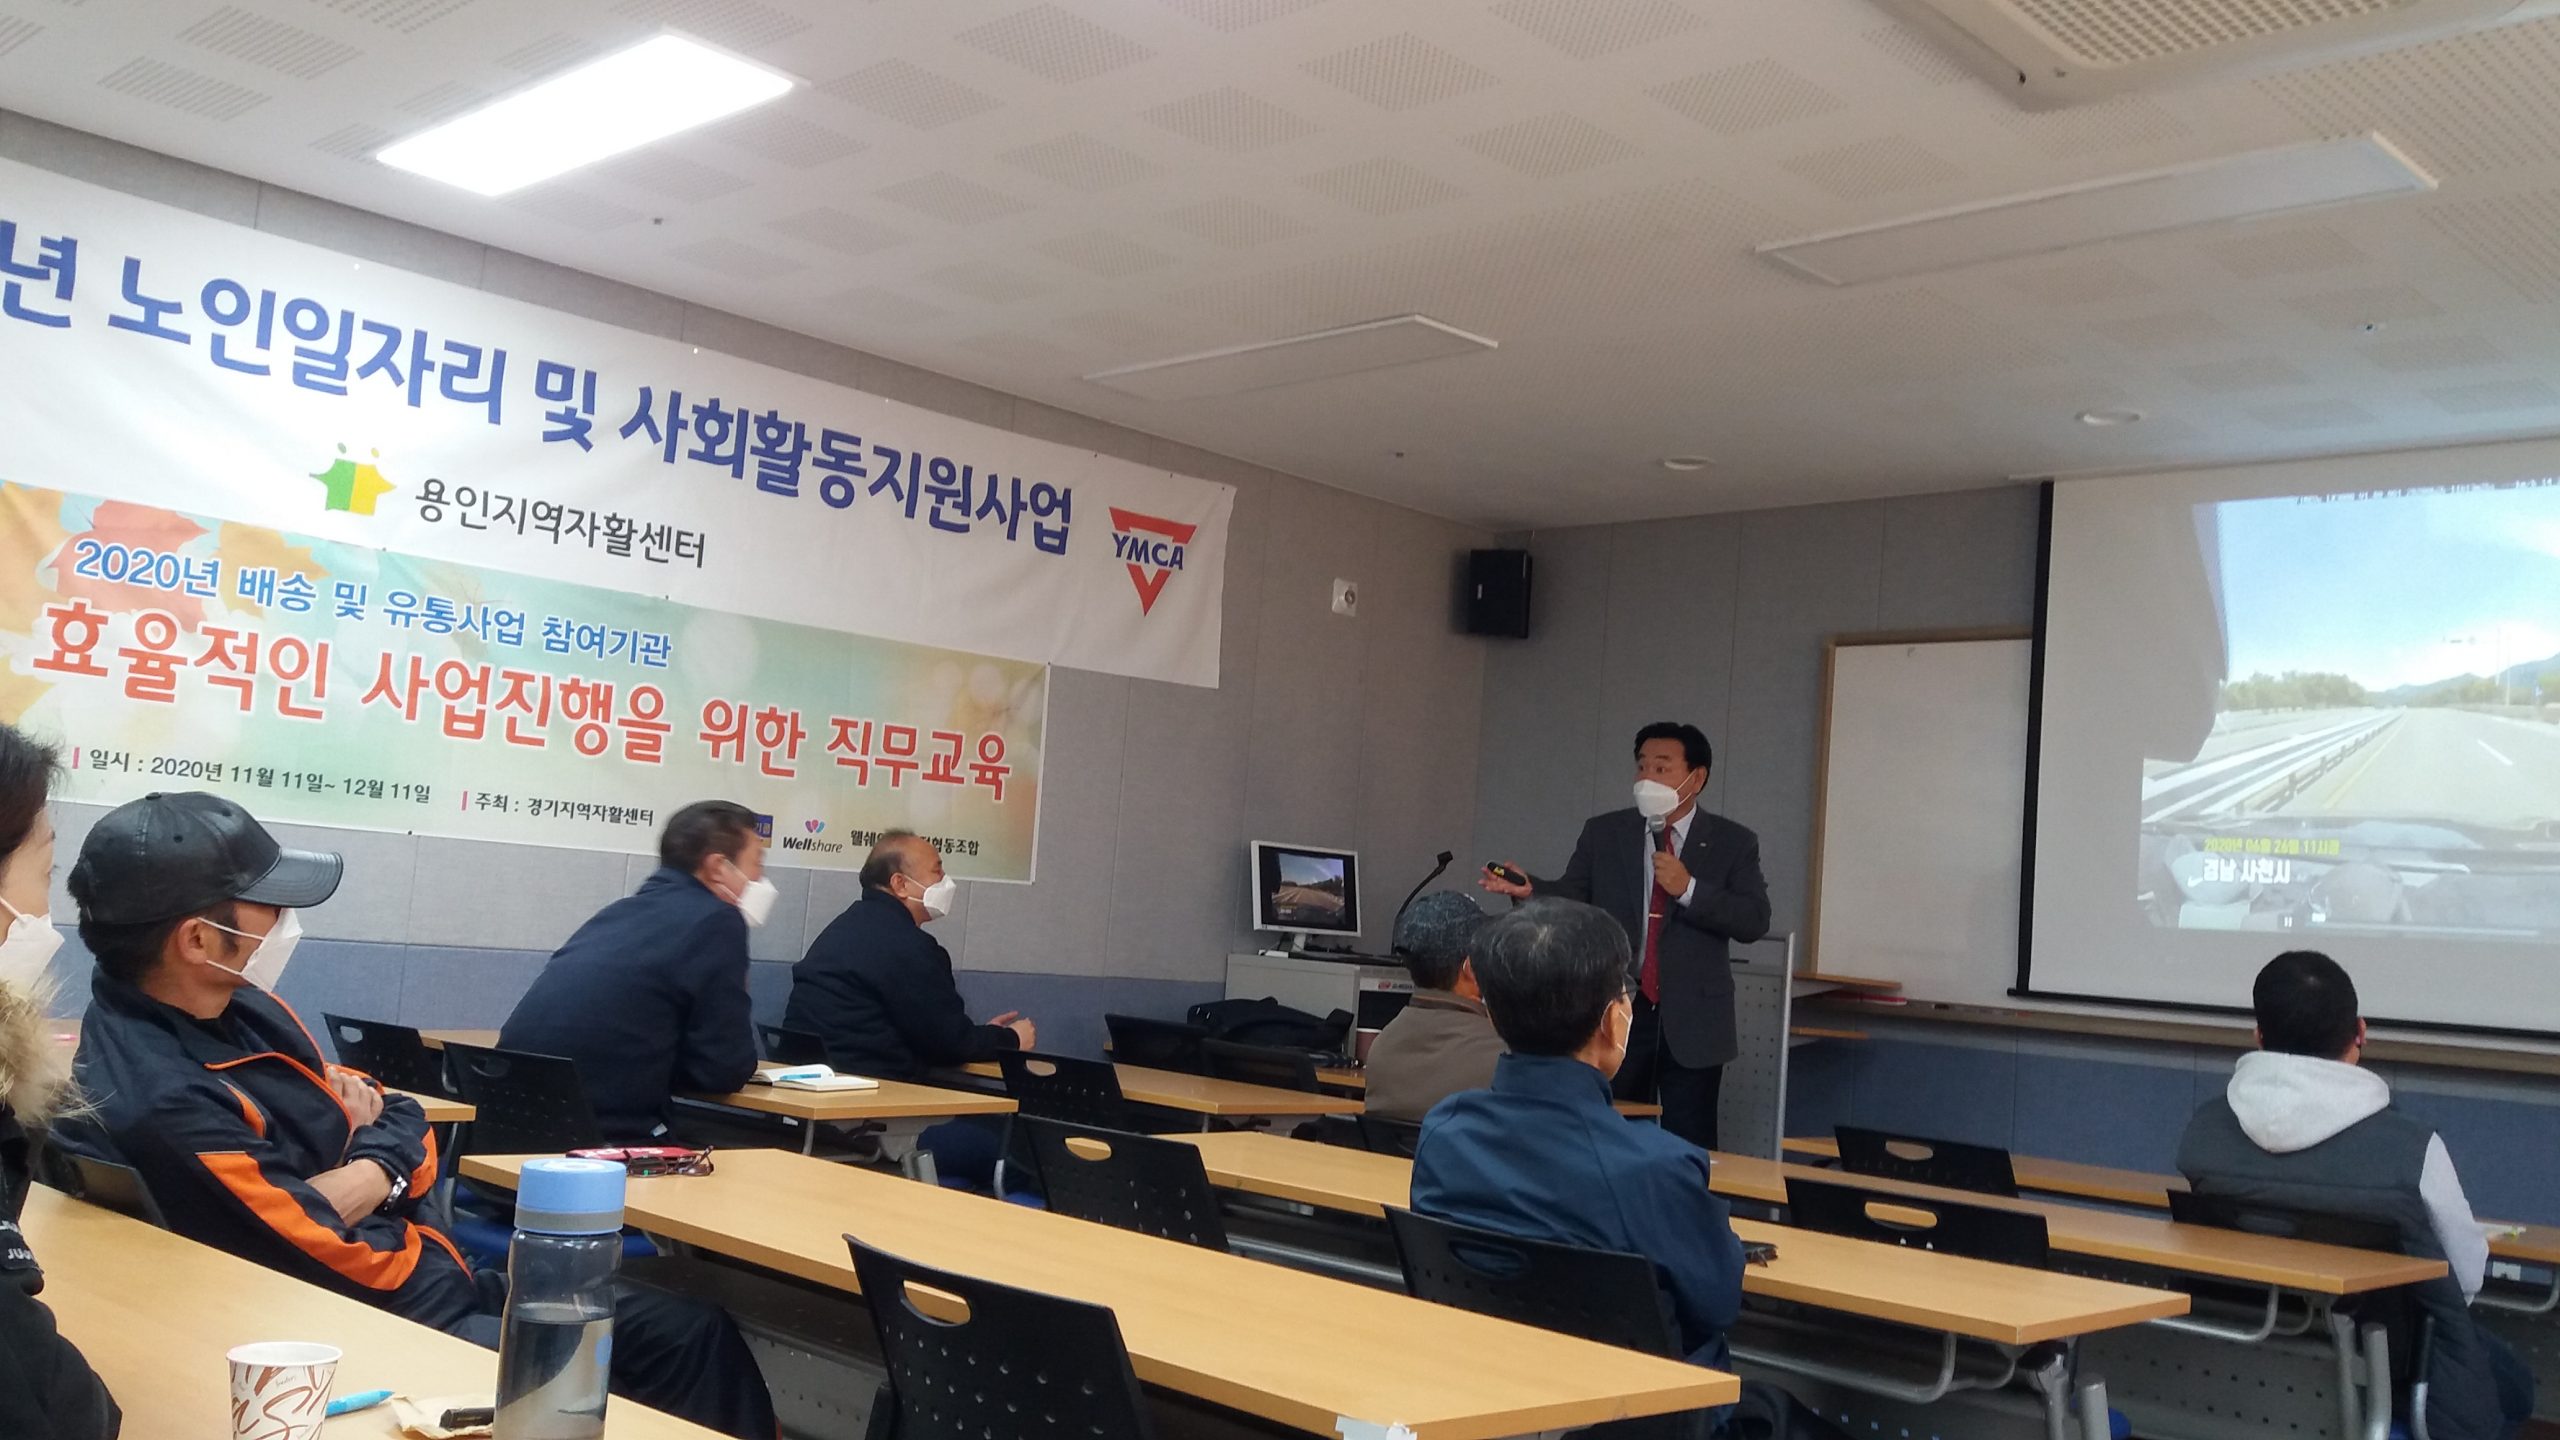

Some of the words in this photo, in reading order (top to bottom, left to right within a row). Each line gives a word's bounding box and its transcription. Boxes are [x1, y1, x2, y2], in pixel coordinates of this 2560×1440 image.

[0, 219, 78, 328] 년
[108, 255, 507, 425] 노인일자리
[535, 359, 597, 453] 및
[620, 385, 1072, 556] 사회활동지원사업
[415, 477, 705, 568] 용인지역자활센터
[1111, 532, 1185, 571] YMCA
[75, 540, 220, 597] 2020년
[238, 565, 317, 612] 배송
[332, 581, 367, 621] 및
[383, 591, 526, 646] 유통사업
[541, 615, 671, 668] 참여기관
[33, 601, 330, 719] 효율적인
[361, 651, 671, 764] 사업진행을
[700, 699, 806, 778] 위한
[827, 717, 1011, 801] 직무교육
[90, 749, 130, 772] 일시
[150, 756, 223, 782] 2020년
[230, 767, 274, 788] 11월
[343, 778, 383, 799] 12월
[390, 783, 430, 804] 11일
[475, 792, 508, 812] 주최
[527, 798, 654, 826] 경기지역자활센터
[783, 836, 843, 853] Wellshare
